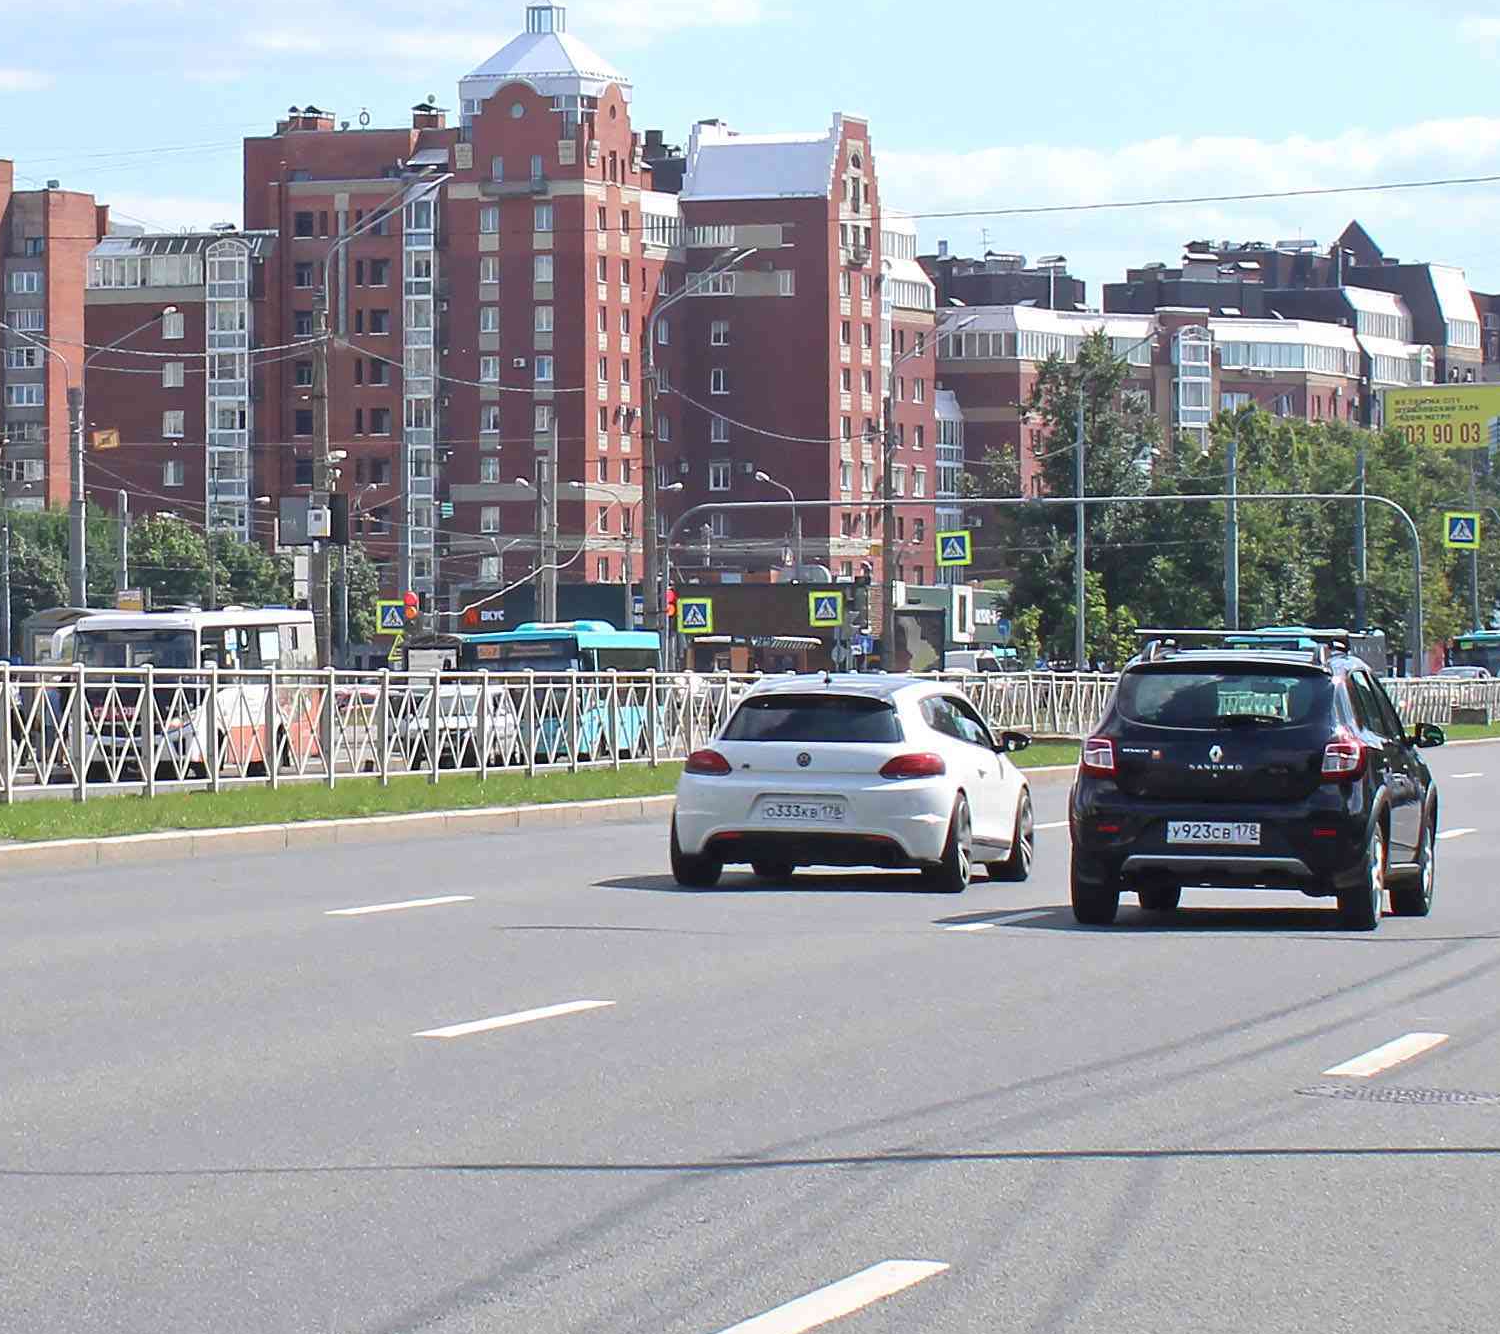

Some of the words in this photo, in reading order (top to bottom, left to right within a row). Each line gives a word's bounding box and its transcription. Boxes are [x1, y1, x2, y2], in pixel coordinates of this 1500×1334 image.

[1432, 423, 1453, 444] 90
[1460, 422, 1481, 443] 03
[1172, 824, 1231, 839] У923СВ
